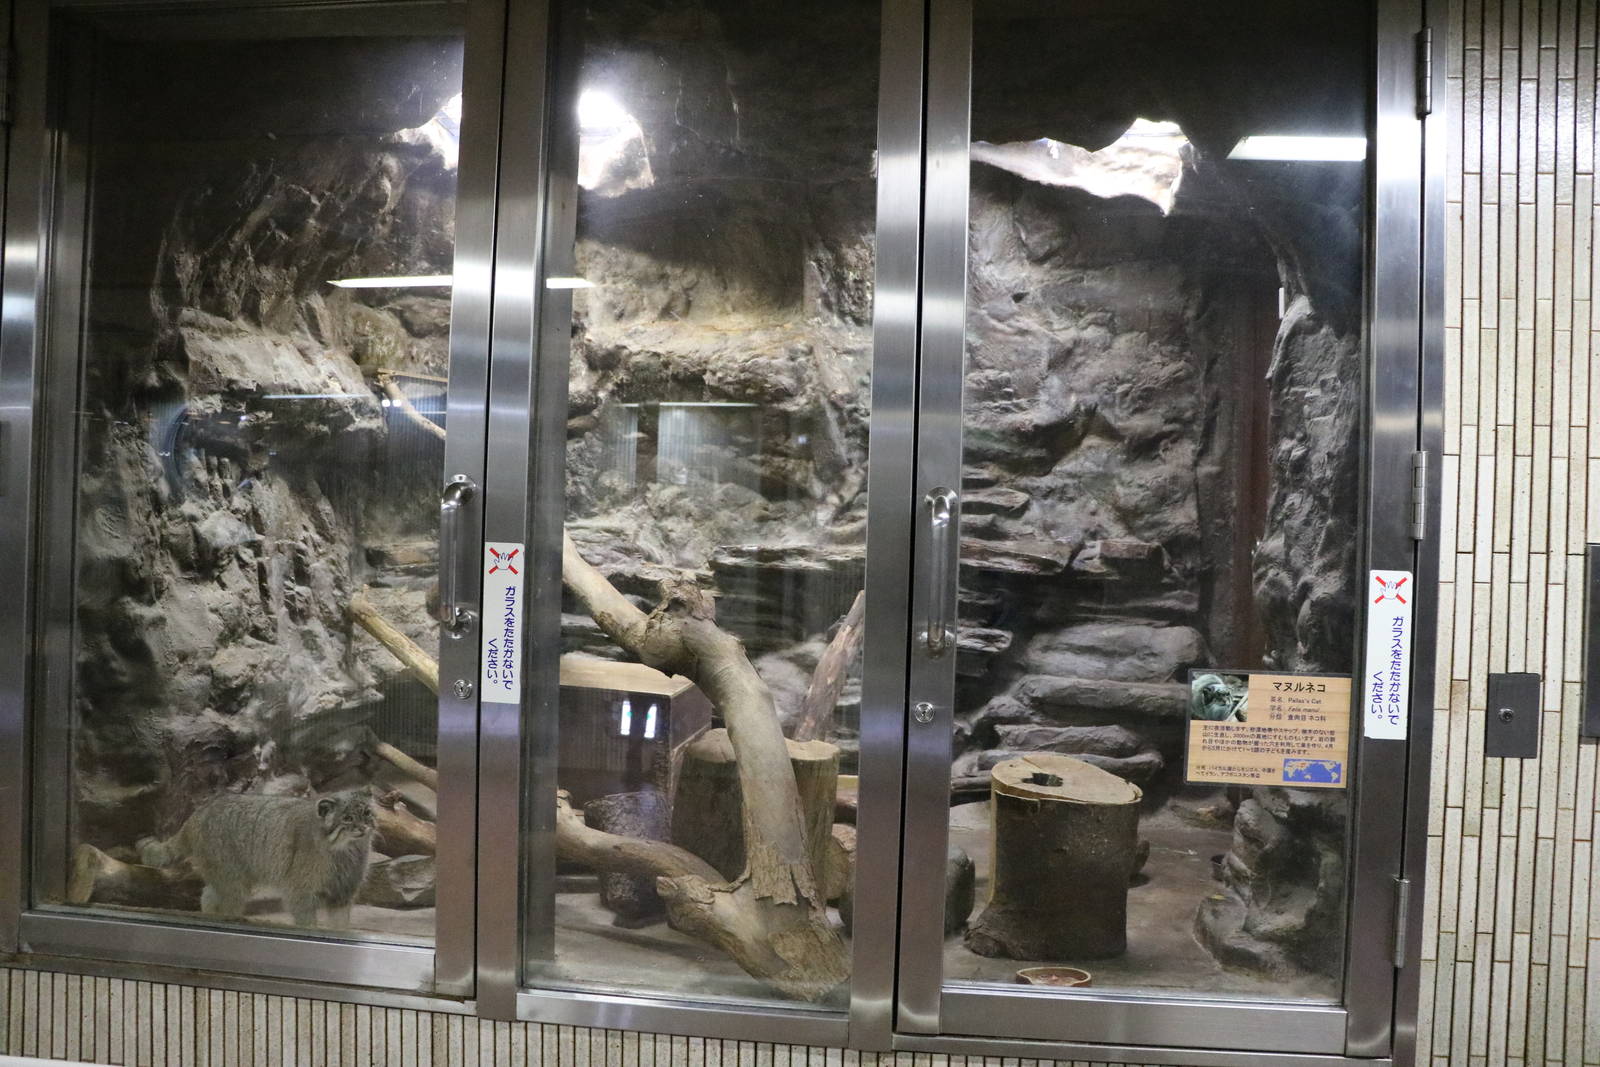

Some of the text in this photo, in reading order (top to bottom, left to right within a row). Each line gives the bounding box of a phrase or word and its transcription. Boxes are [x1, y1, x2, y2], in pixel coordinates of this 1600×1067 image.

[487, 638, 498, 684] ください。
[502, 585, 516, 690] ガラスをたたかないで
[1272, 682, 1326, 693] マヌルネコ
[1388, 616, 1404, 725] ガラスをたたかないで
[1371, 671, 1383, 720] ください。
